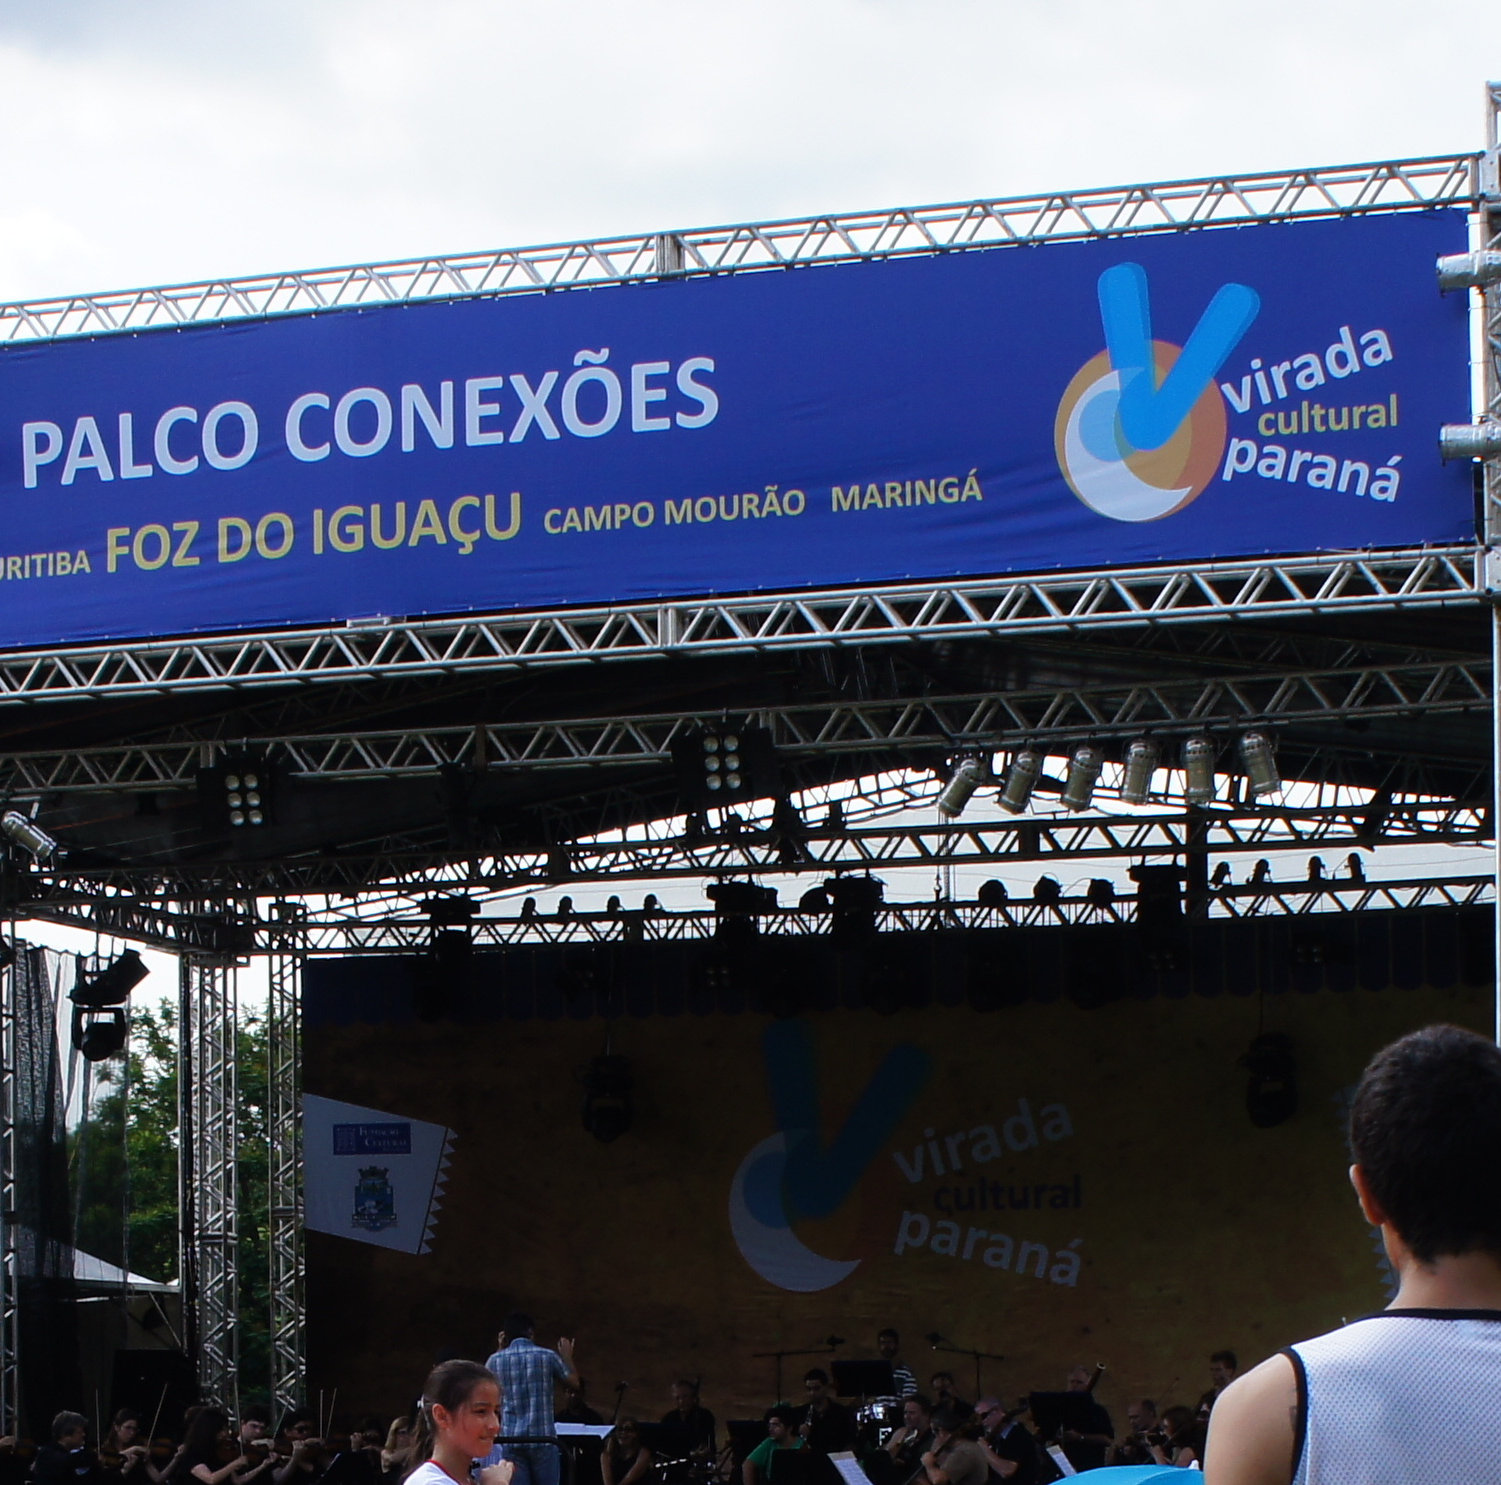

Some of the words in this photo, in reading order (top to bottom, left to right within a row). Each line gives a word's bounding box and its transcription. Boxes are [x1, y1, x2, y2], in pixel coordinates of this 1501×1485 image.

[1220, 324, 1395, 417] virada
[22, 401, 260, 489] PALCO
[284, 347, 720, 463] CONEXÕES
[1257, 394, 1399, 438] cultural
[1222, 435, 1402, 503] paraná
[106, 520, 200, 573] FOZ
[218, 511, 296, 563] DO
[313, 492, 522, 554] IGUAÇU
[544, 501, 655, 535] CAMPO
[665, 488, 806, 524] MOURÃO
[831, 470, 984, 512] MARINGÁ
[891, 1097, 1075, 1185] virada
[933, 1174, 1083, 1212] cultural
[892, 1210, 1084, 1287] paraná
